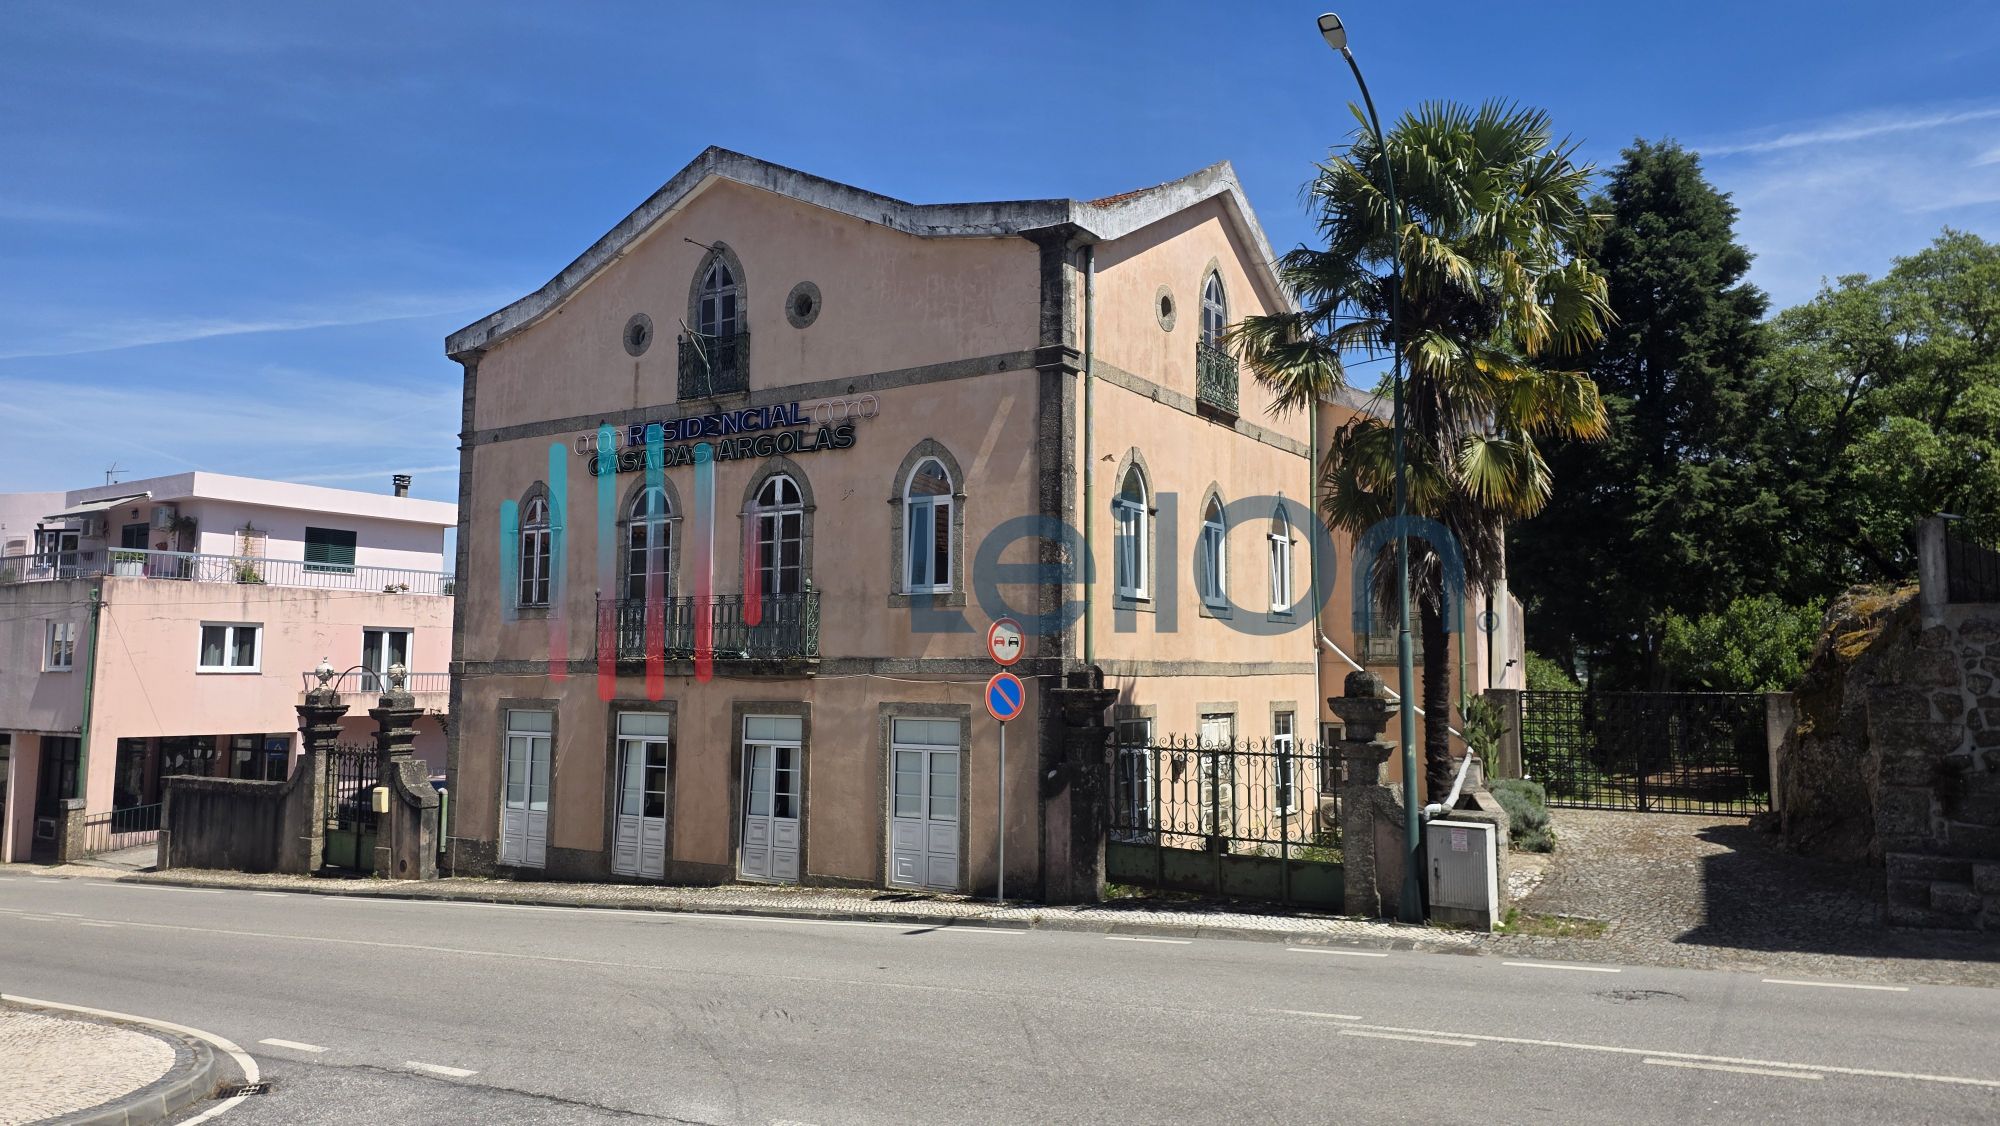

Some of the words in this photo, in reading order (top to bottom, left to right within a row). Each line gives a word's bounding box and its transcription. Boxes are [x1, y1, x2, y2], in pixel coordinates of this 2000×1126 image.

[627, 403, 810, 446] RESIDENCIAL
[588, 450, 657, 477] CASA
[659, 441, 714, 468] DAS
[716, 424, 857, 462] ARGOLAS
